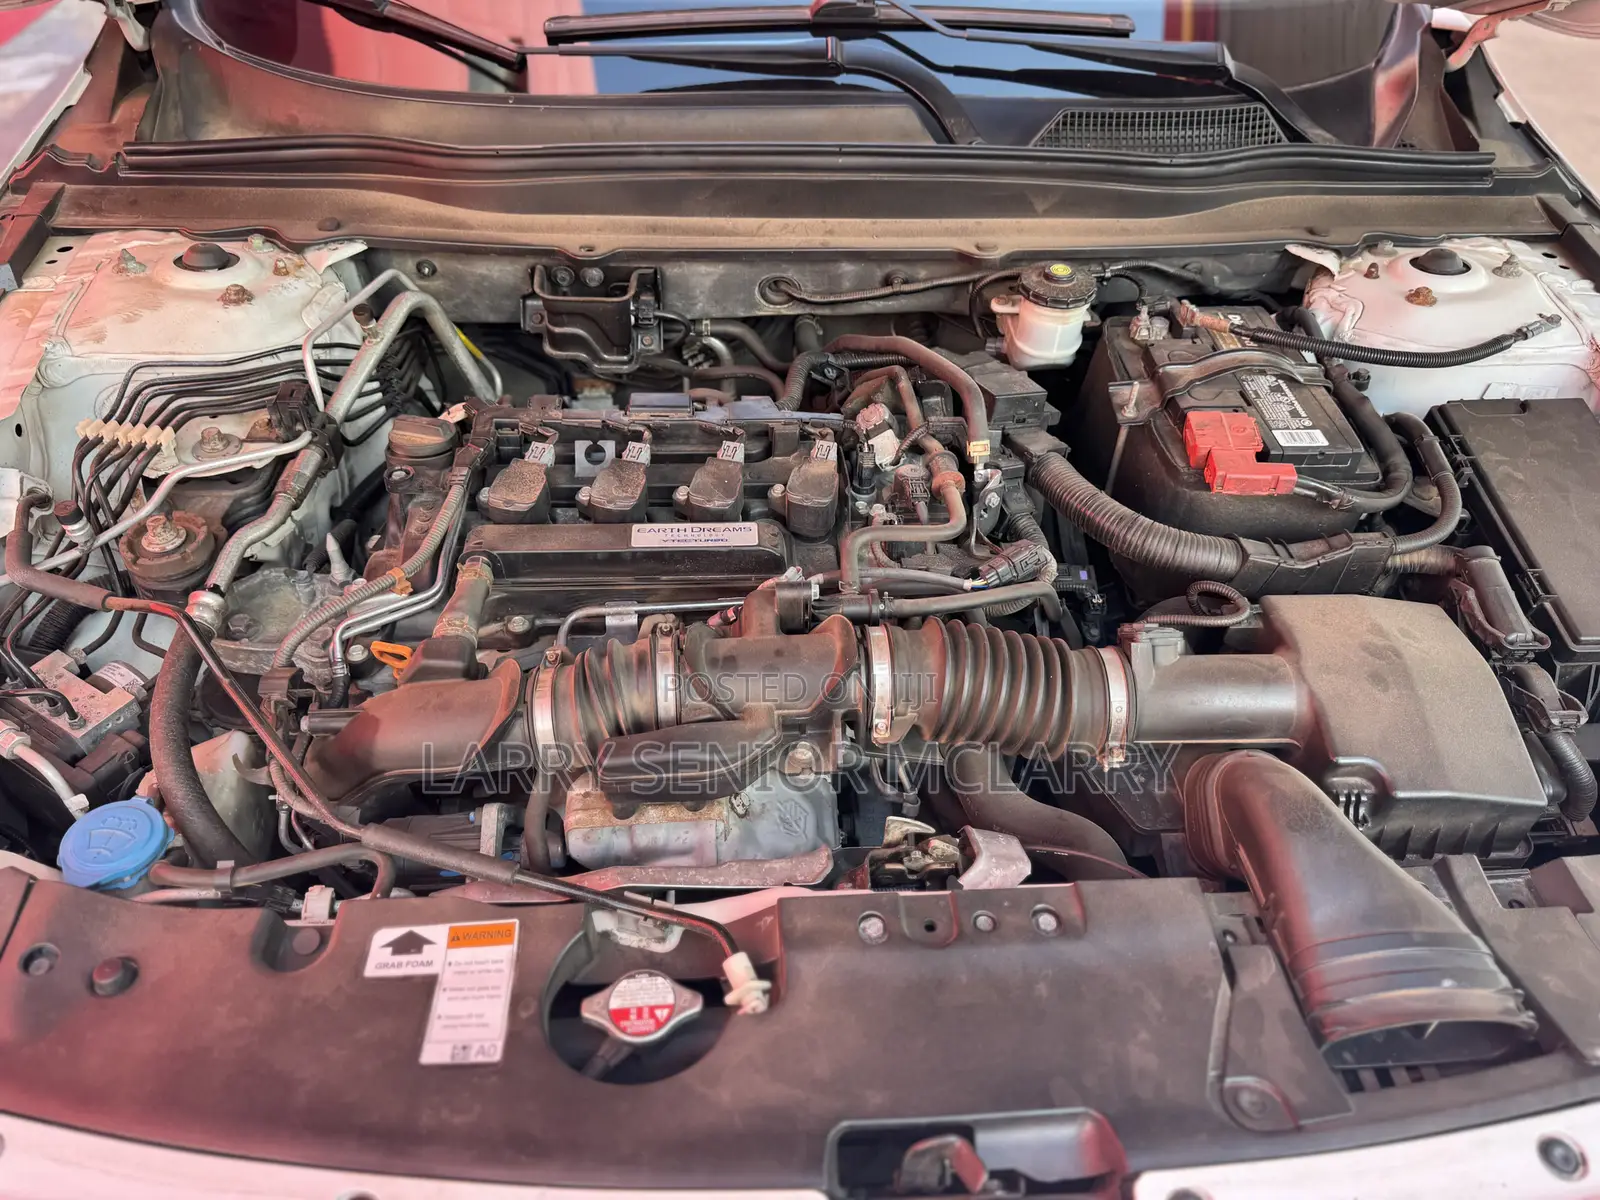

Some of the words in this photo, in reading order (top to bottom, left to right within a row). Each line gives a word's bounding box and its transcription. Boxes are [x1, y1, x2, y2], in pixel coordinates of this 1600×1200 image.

[462, 929, 512, 941] WARNING
[374, 961, 404, 970] GRAB
[405, 959, 434, 968] FOAM
